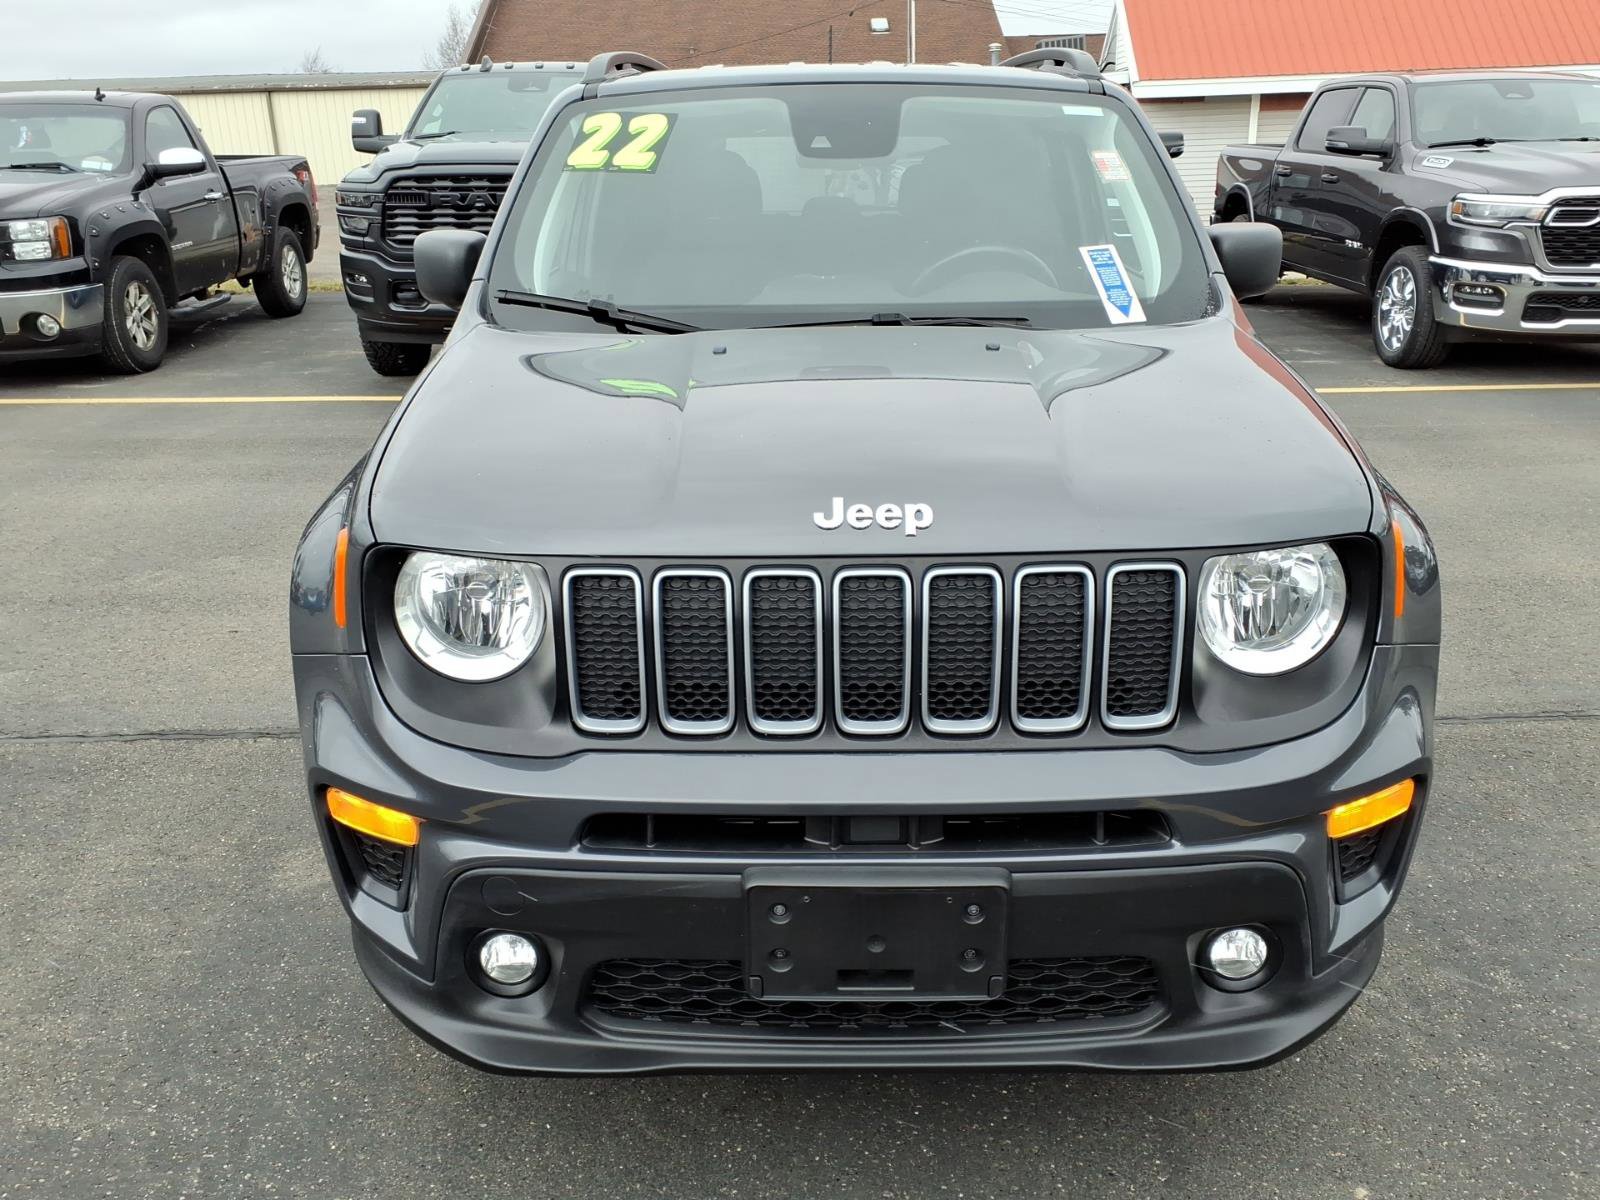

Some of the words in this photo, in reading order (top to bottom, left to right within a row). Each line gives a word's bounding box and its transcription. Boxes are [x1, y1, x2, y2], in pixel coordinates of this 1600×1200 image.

[566, 112, 669, 170] 22
[430, 191, 506, 208] RA
[813, 496, 934, 537] Jeep
